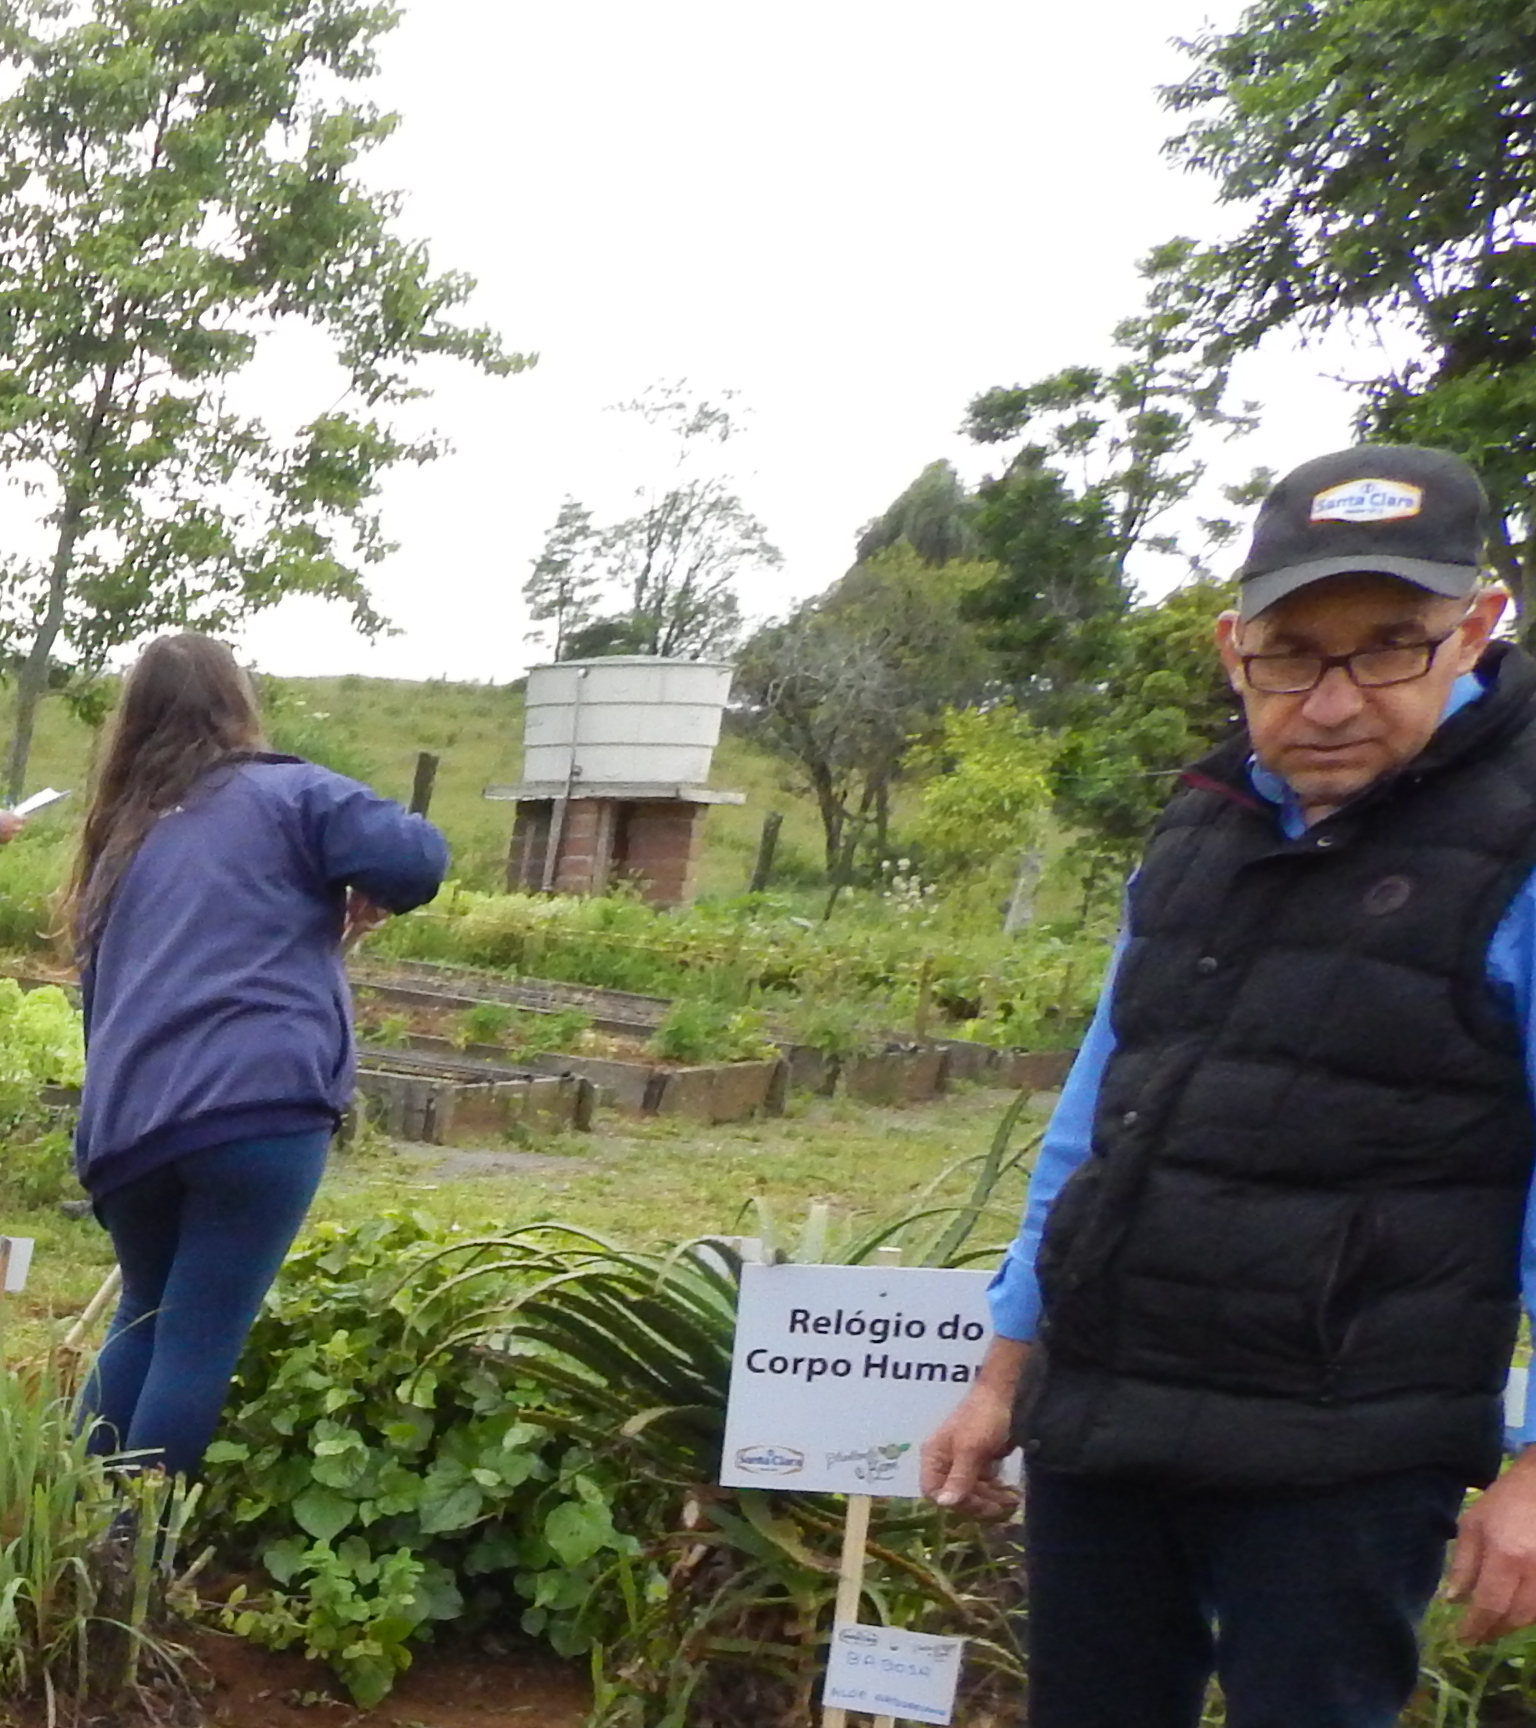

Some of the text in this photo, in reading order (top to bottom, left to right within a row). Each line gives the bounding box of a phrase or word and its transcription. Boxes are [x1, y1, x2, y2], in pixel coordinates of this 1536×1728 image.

[1316, 492, 1415, 513] Santa Clara
[788, 1308, 984, 1344] Relógio do
[746, 1348, 984, 1383] Corpo Huma
